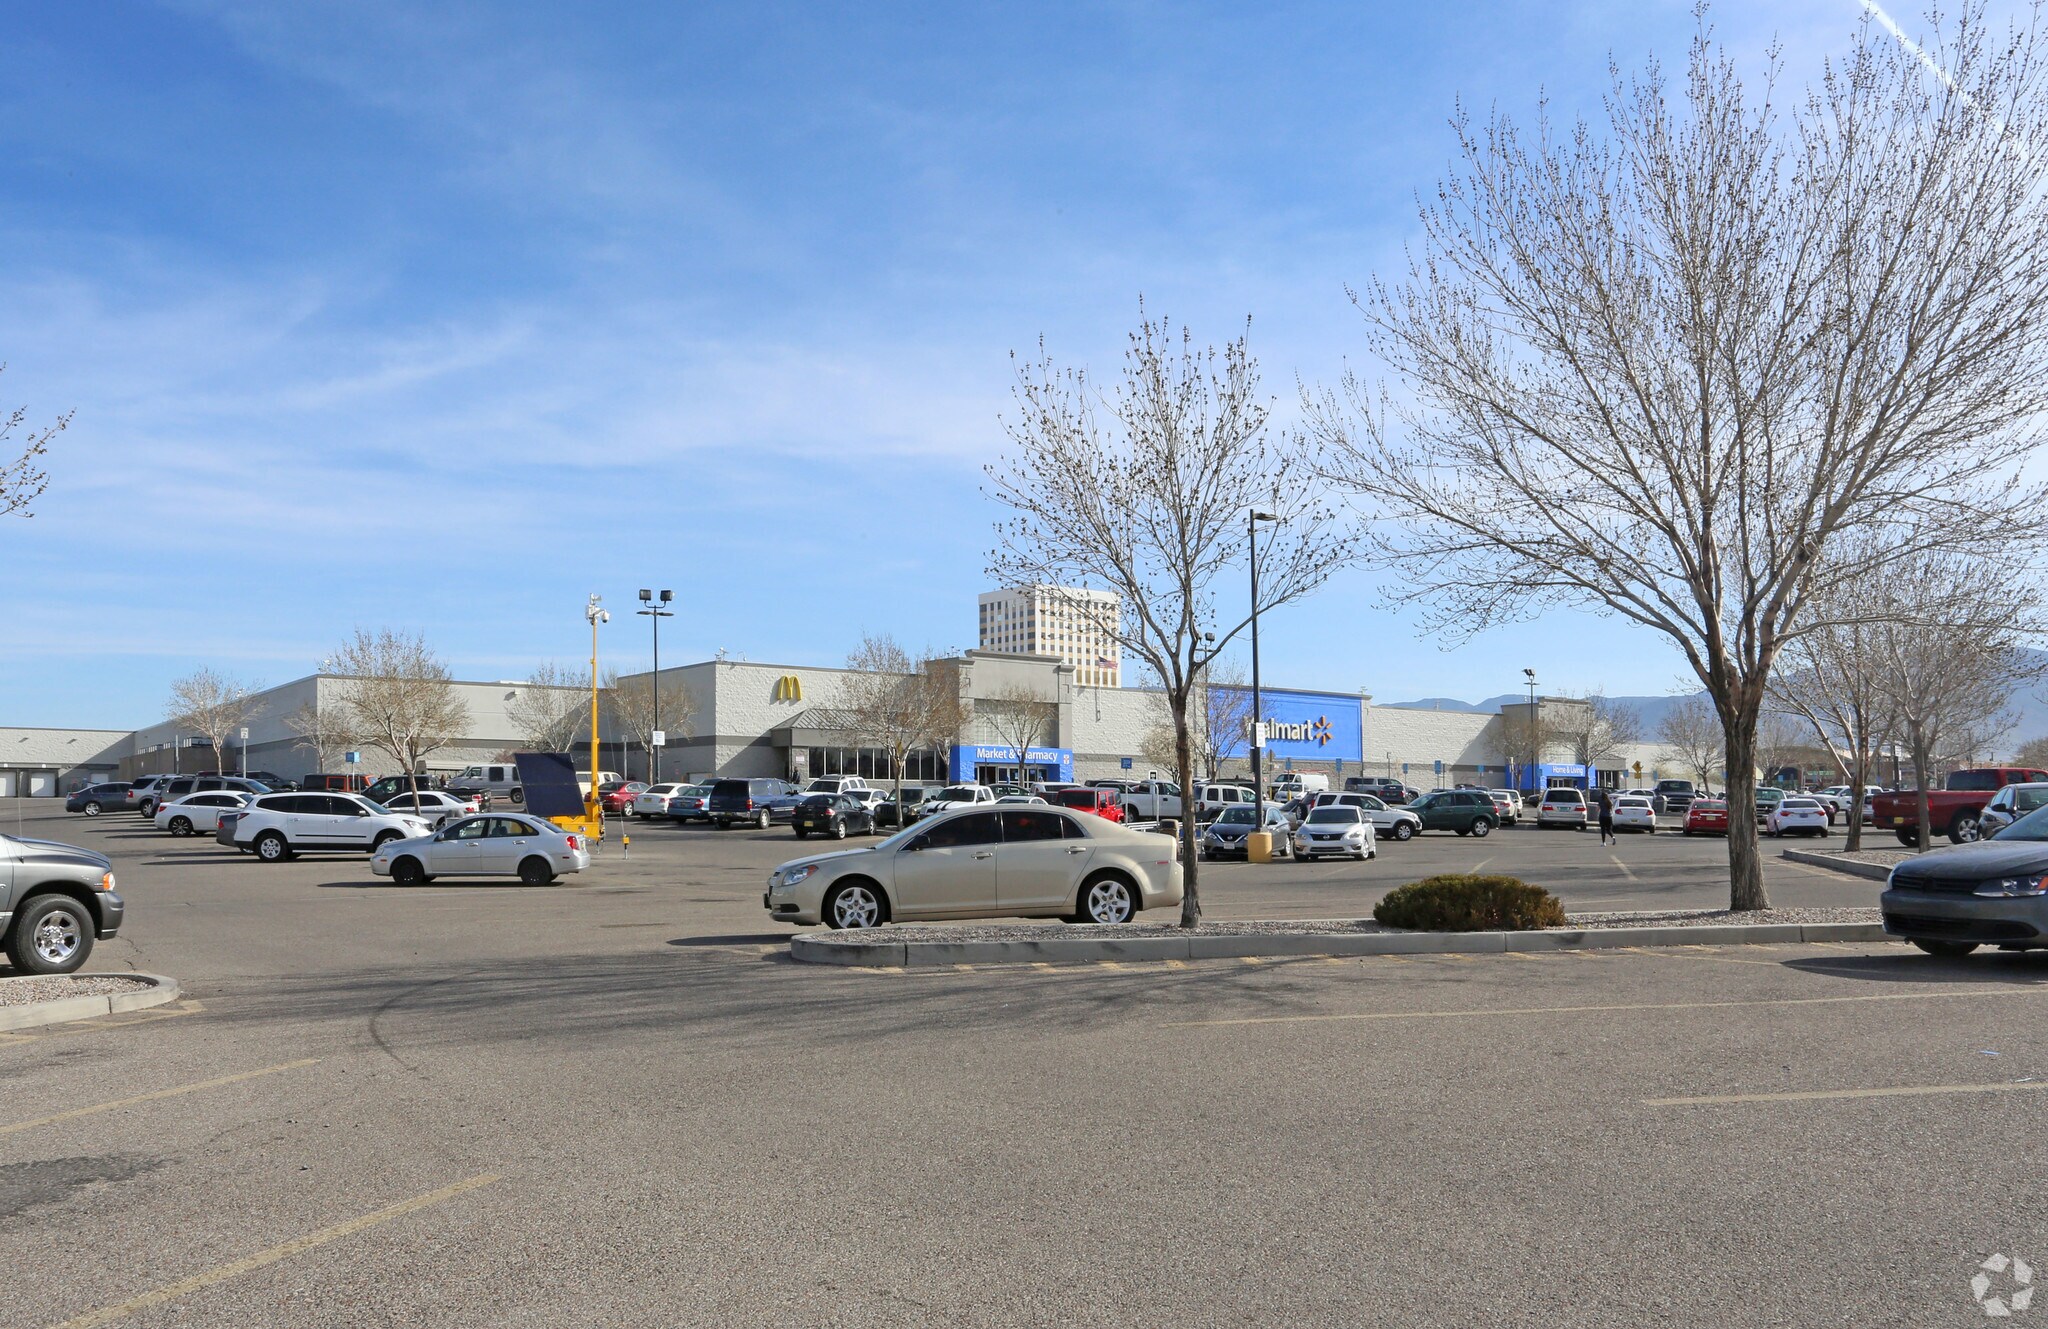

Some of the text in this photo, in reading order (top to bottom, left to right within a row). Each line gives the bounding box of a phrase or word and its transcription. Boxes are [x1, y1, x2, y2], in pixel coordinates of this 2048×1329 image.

[1243, 716, 1314, 741] almart
[976, 748, 1007, 759] Market
[1008, 748, 1016, 760] &
[1552, 765, 1566, 774] Home
[1570, 766, 1584, 776] Living
